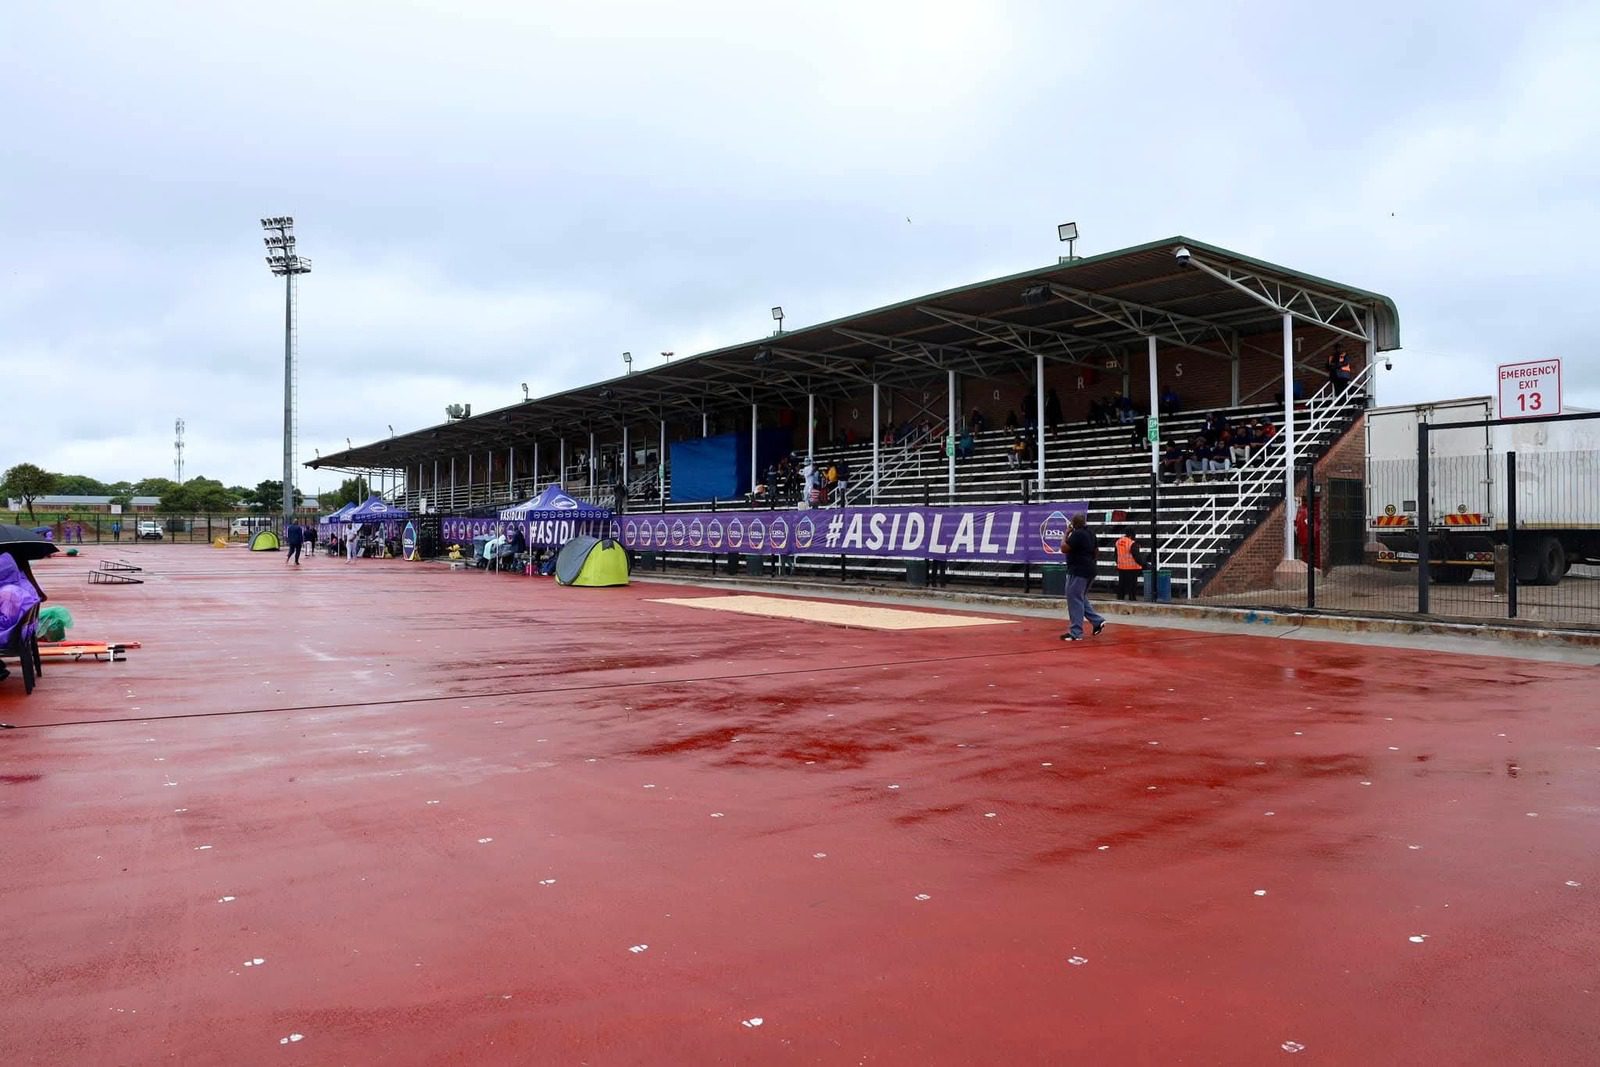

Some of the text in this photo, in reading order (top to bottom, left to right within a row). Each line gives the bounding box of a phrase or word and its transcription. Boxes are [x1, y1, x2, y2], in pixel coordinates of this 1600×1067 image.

[1295, 336, 1305, 353] T
[1175, 363, 1184, 376] S
[1501, 364, 1557, 380] EMERGENCY
[1077, 375, 1085, 390] R
[1519, 379, 1539, 390] EXIT
[1517, 392, 1542, 412] 13
[825, 511, 1022, 555] #ASIDLALI
